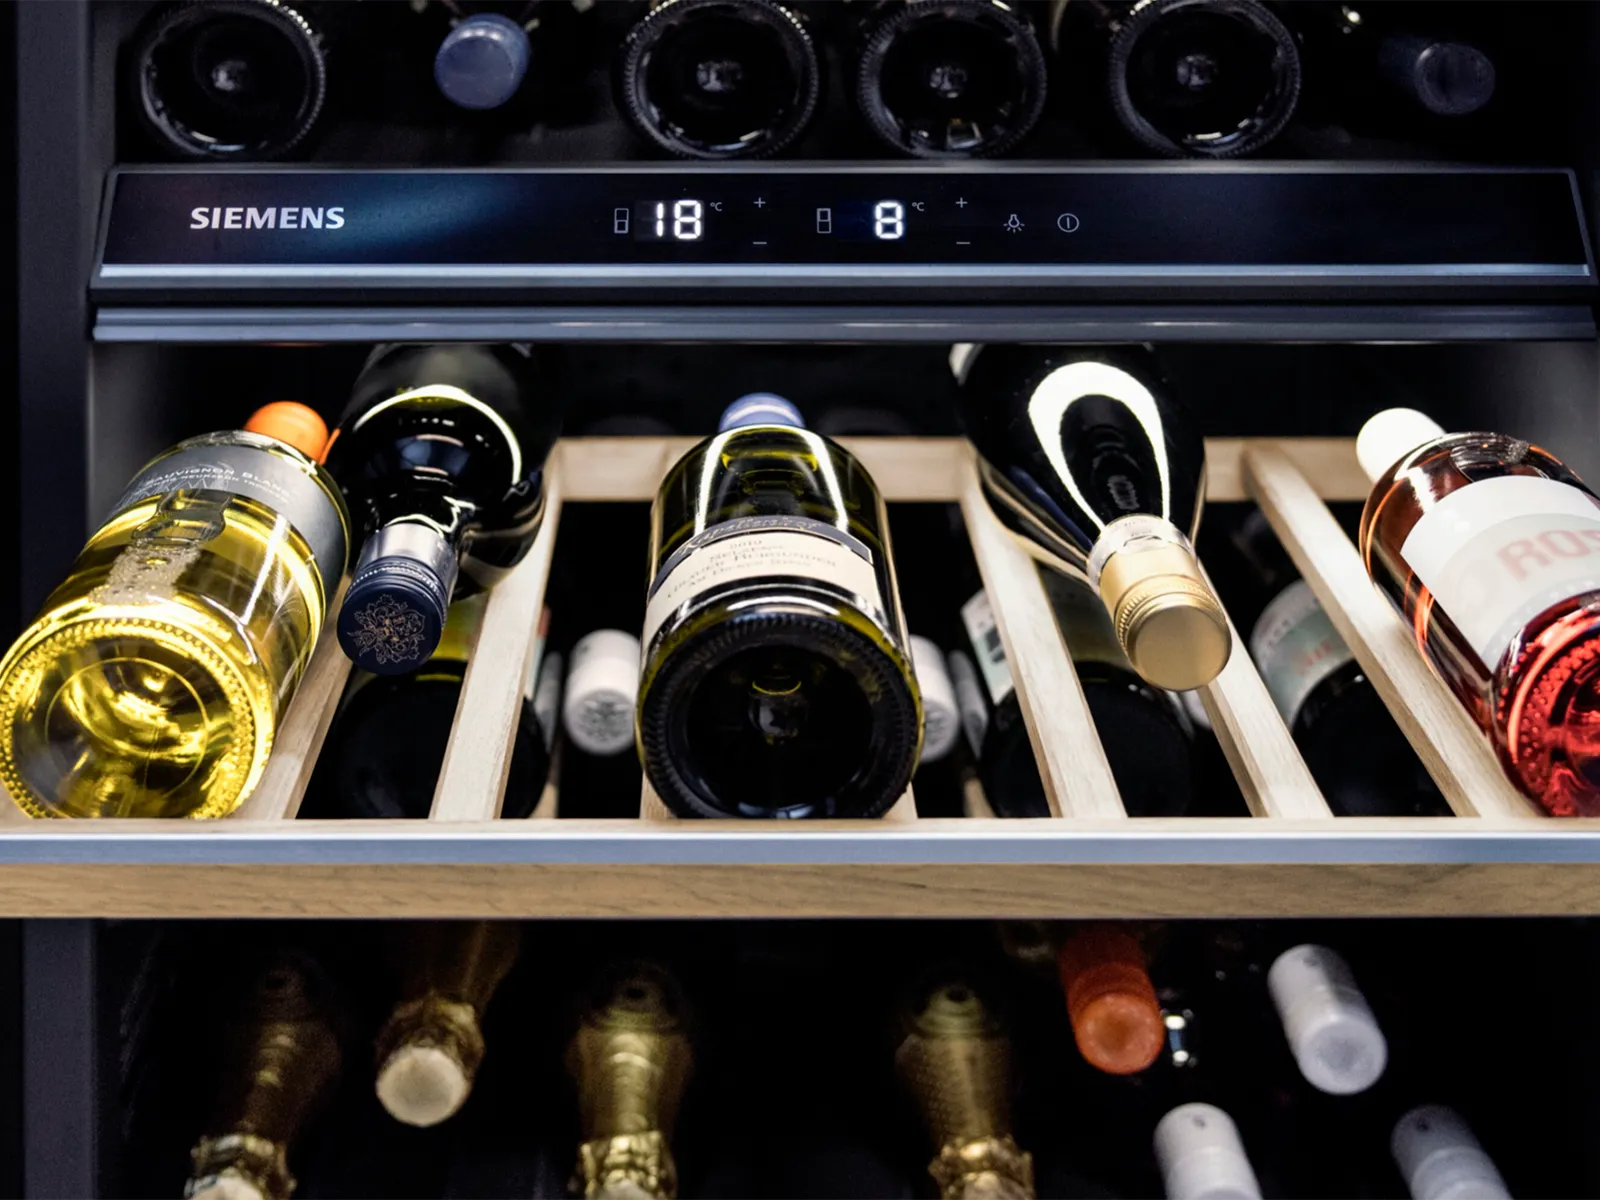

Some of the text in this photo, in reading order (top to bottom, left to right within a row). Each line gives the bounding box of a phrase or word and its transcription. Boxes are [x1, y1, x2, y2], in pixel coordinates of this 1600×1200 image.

[190, 207, 345, 229] SIEMENS
[656, 200, 702, 240] 18
[875, 202, 904, 239] 8
[145, 467, 291, 497] SAUVIGNON BLANC
